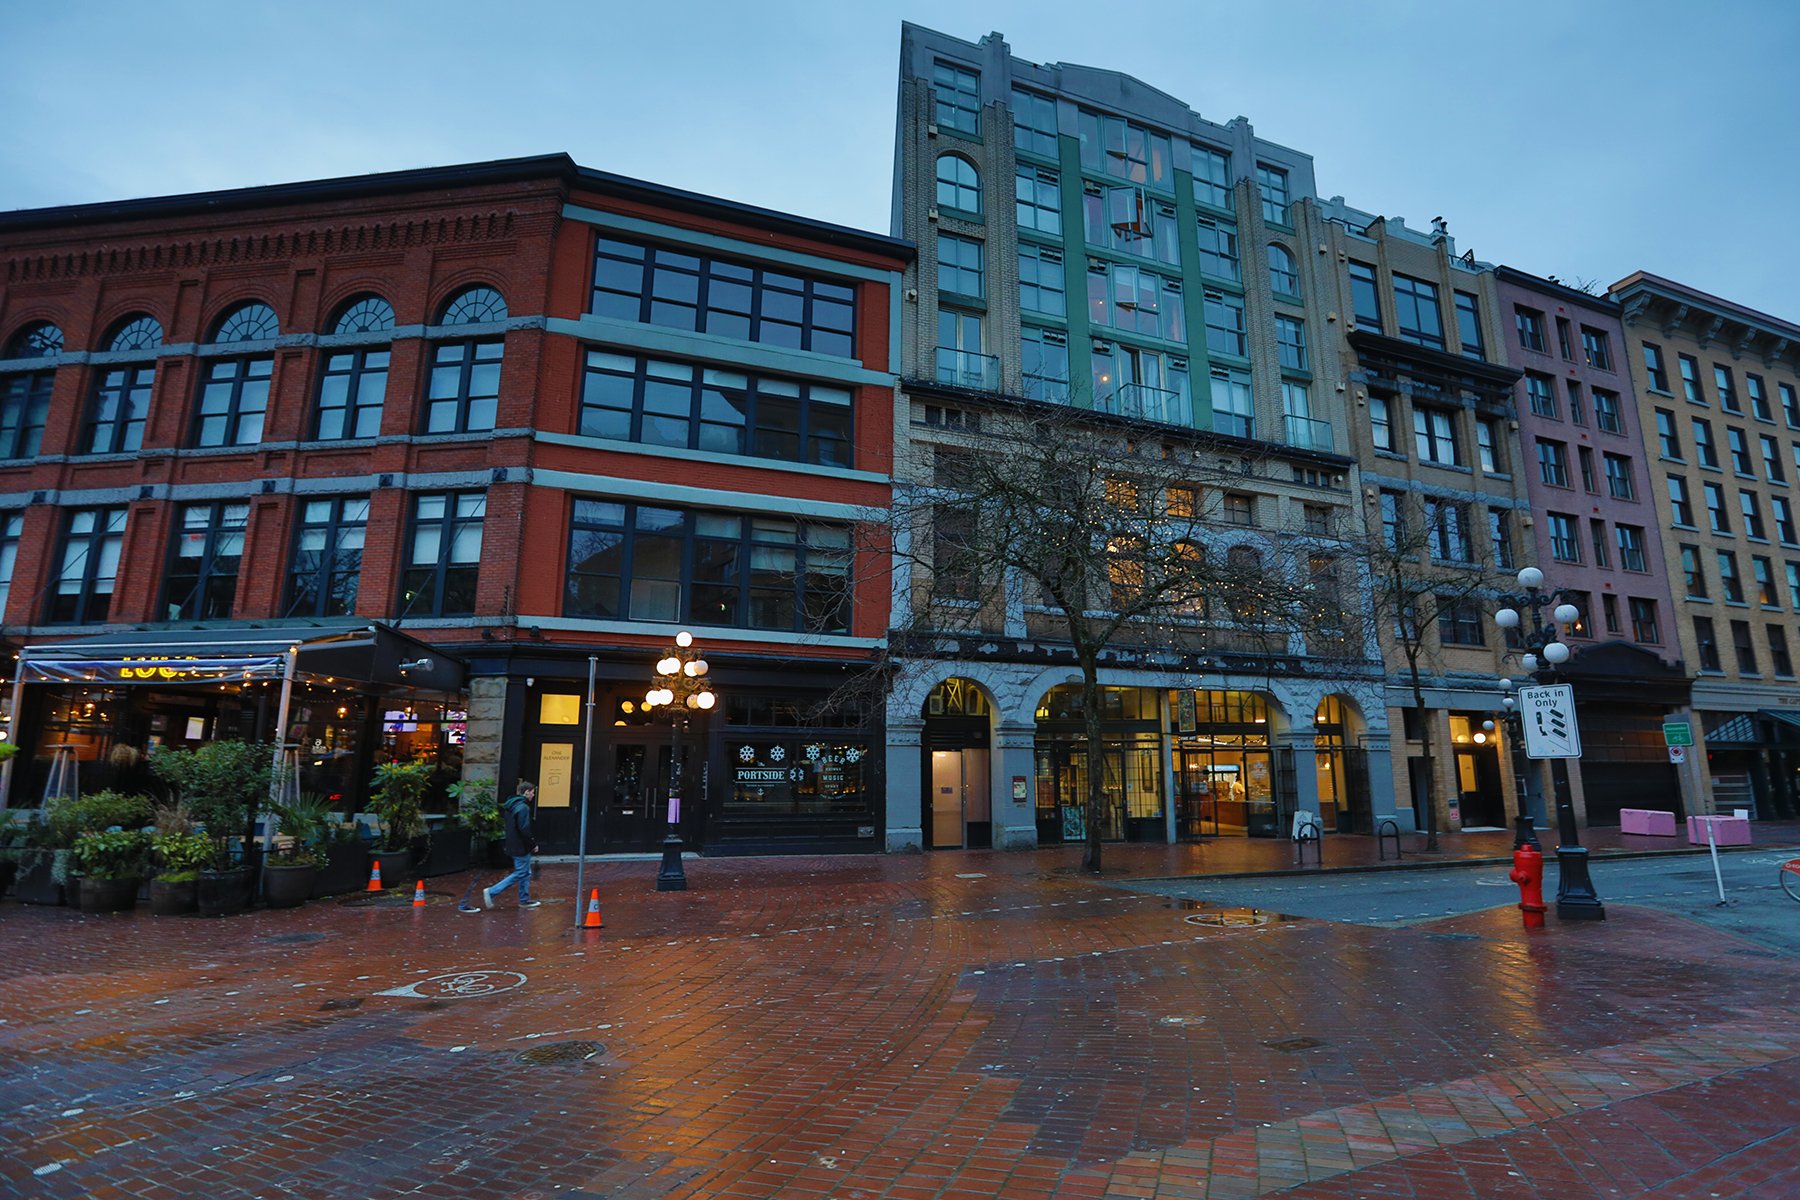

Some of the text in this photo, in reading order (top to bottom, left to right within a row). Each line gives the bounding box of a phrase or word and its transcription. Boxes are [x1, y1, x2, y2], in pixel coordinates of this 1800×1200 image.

[1527, 689, 1564, 699] Back in
[1535, 699, 1558, 708] Only
[821, 754, 846, 765] BEER
[737, 770, 785, 780] PORTSIDE
